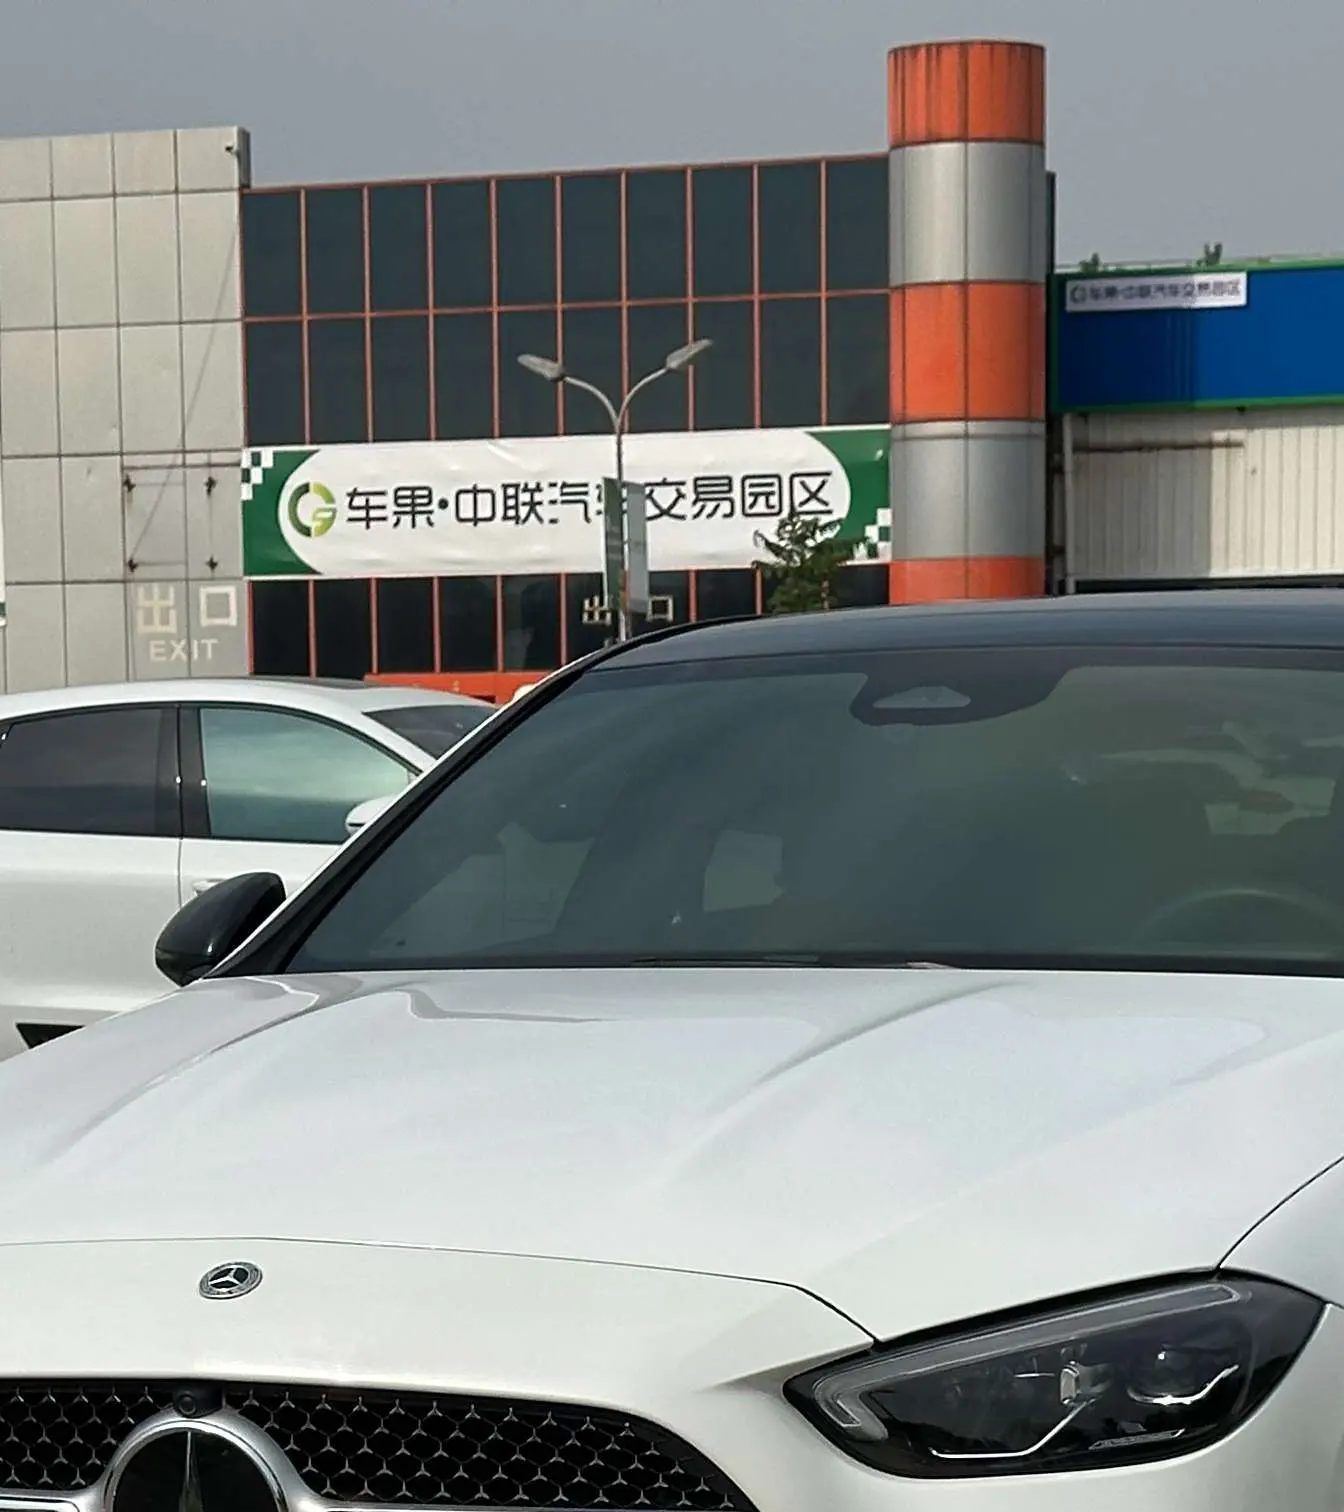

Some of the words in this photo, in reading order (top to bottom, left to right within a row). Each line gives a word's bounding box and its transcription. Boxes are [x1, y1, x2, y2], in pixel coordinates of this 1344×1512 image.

[345, 472, 834, 530] 车果·中联汽交易园区
[137, 585, 237, 633] 出口
[149, 639, 218, 662] EXIT
